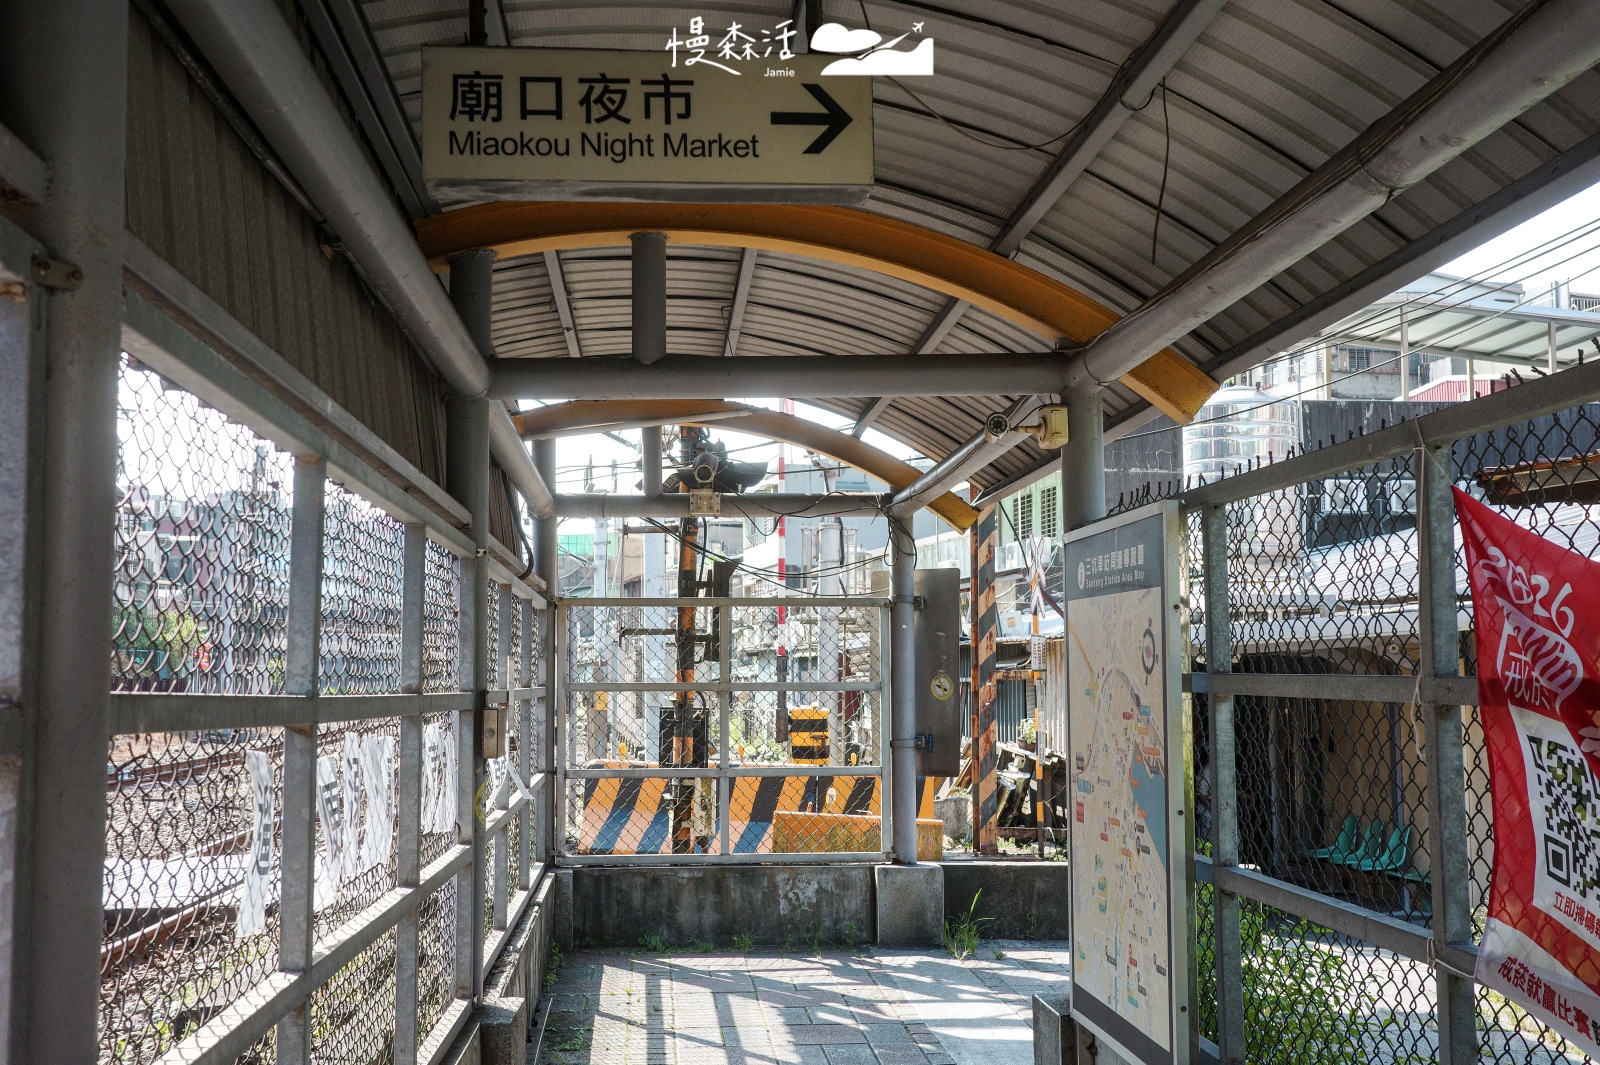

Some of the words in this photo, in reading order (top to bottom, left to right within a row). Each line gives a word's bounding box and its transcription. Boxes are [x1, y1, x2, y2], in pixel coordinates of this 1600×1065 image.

[449, 71, 695, 125] 廟口夜市
[449, 131, 570, 157] Miaokou
[581, 132, 654, 163] Night
[663, 133, 759, 158] Market
[1105, 575, 1121, 585] Station
[1122, 572, 1133, 582] Area
[1134, 570, 1145, 581] Map
